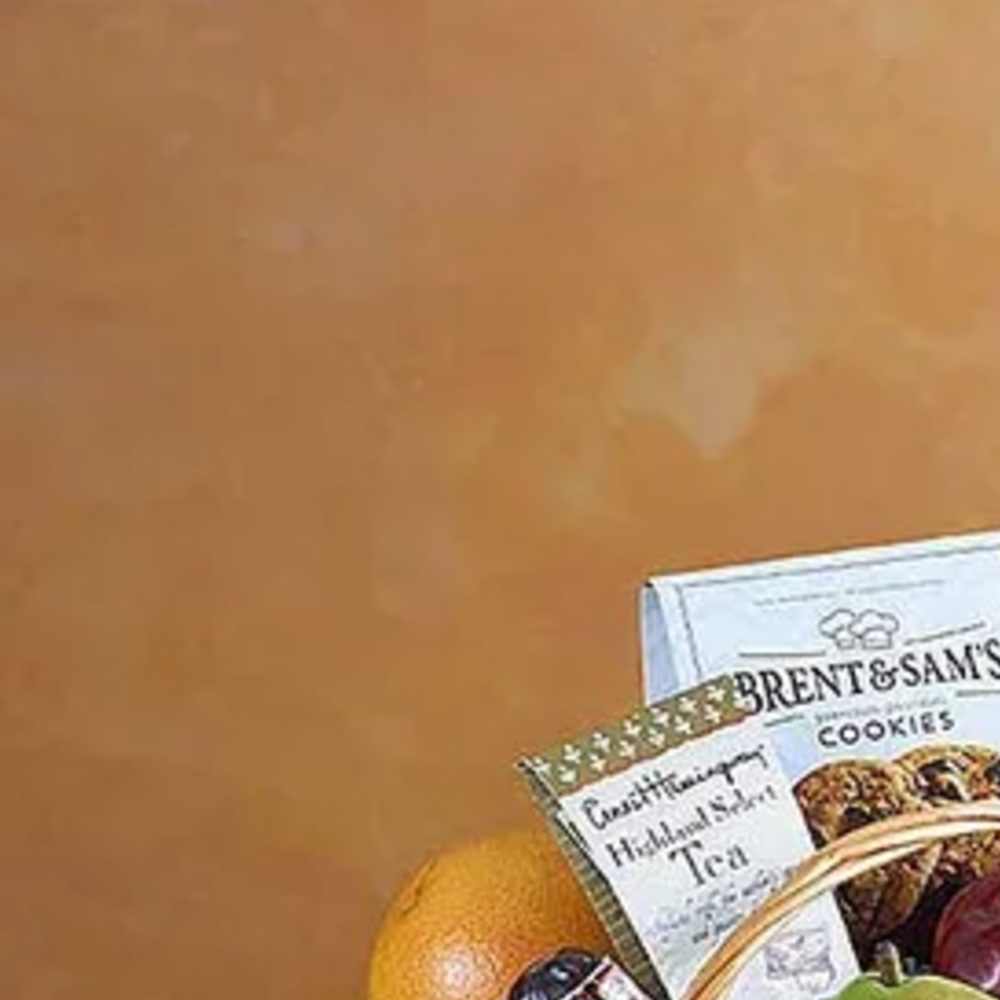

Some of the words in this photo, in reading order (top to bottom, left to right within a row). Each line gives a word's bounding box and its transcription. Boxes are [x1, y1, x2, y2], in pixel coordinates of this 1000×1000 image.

[817, 711, 955, 747] COOKIES
[605, 806, 712, 868] Highland
[709, 785, 777, 822] Select
[668, 840, 749, 885] Tea
